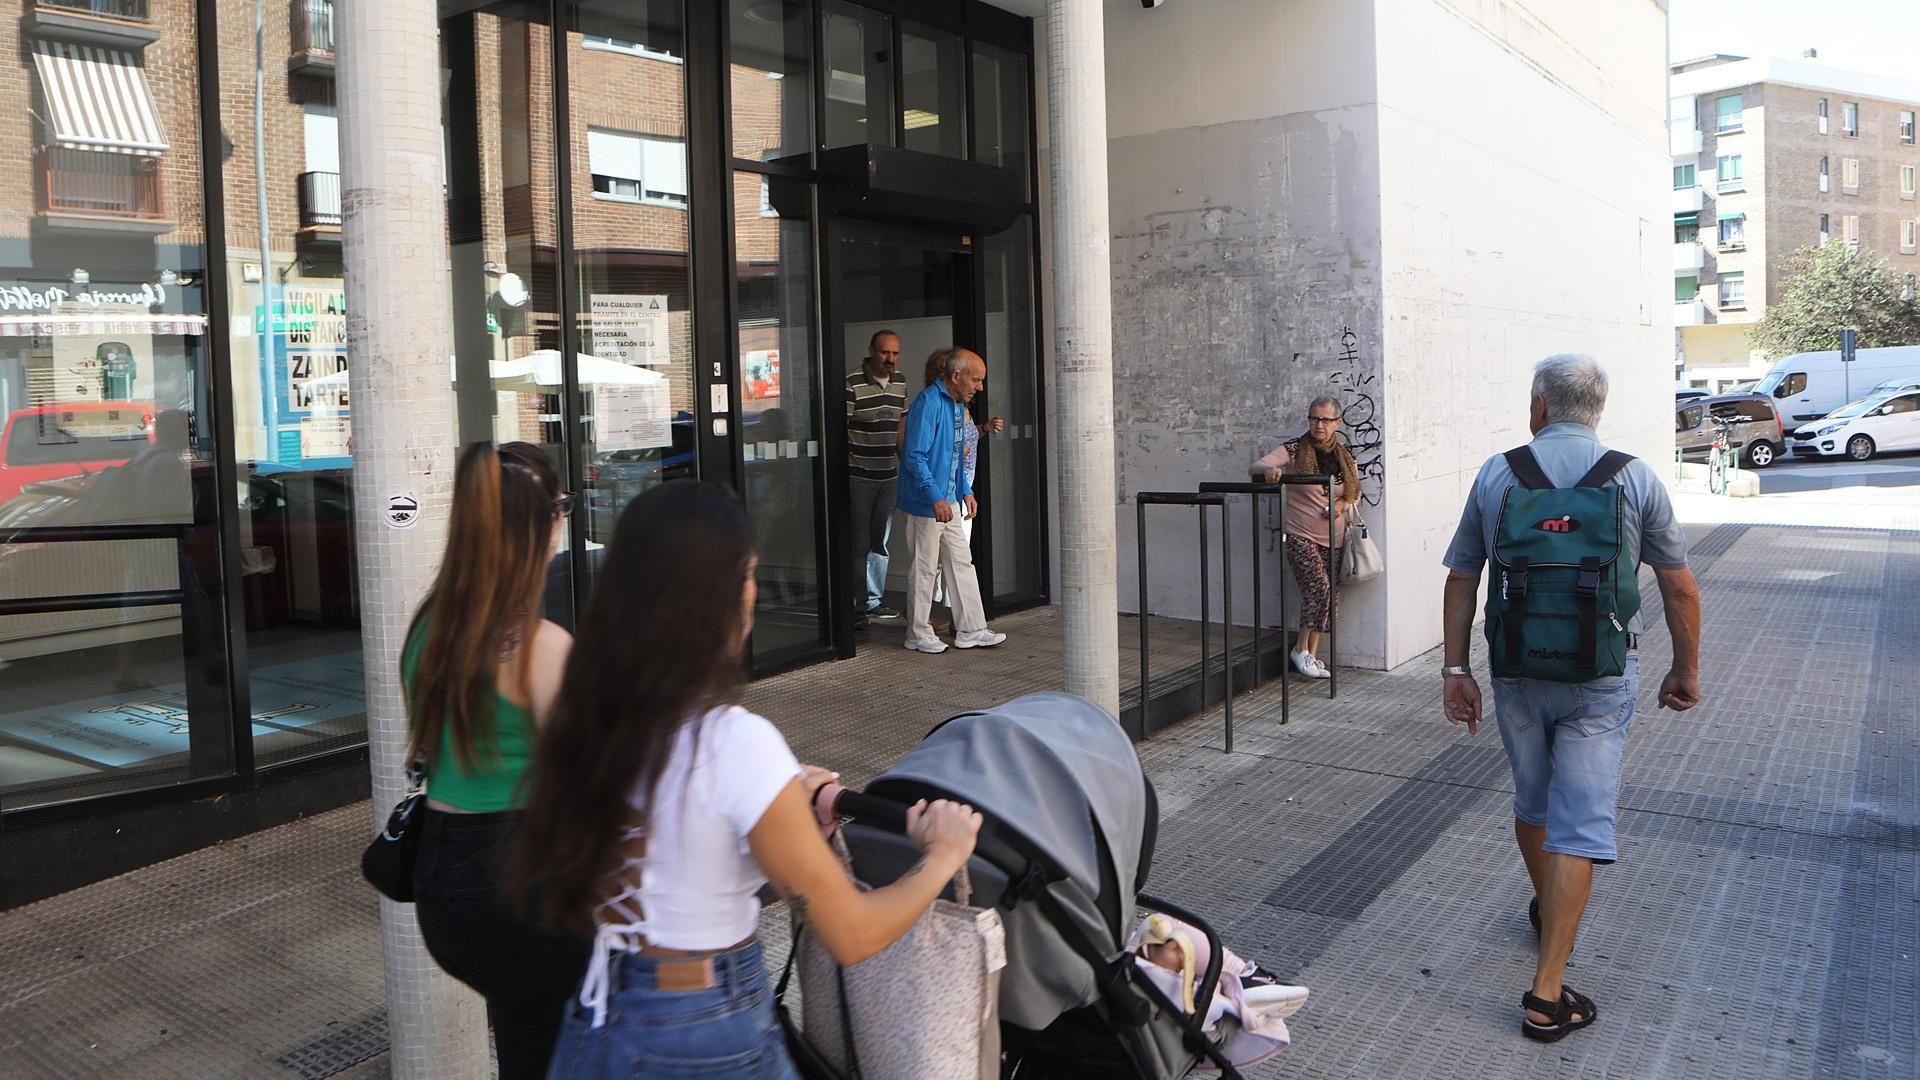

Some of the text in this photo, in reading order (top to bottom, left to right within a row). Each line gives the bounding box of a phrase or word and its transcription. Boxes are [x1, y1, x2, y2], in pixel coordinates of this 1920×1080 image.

[289, 291, 337, 315] VIGILA
[290, 321, 346, 344] DISTANC
[292, 355, 348, 378] ZAIND
[293, 384, 349, 407] TARTE
